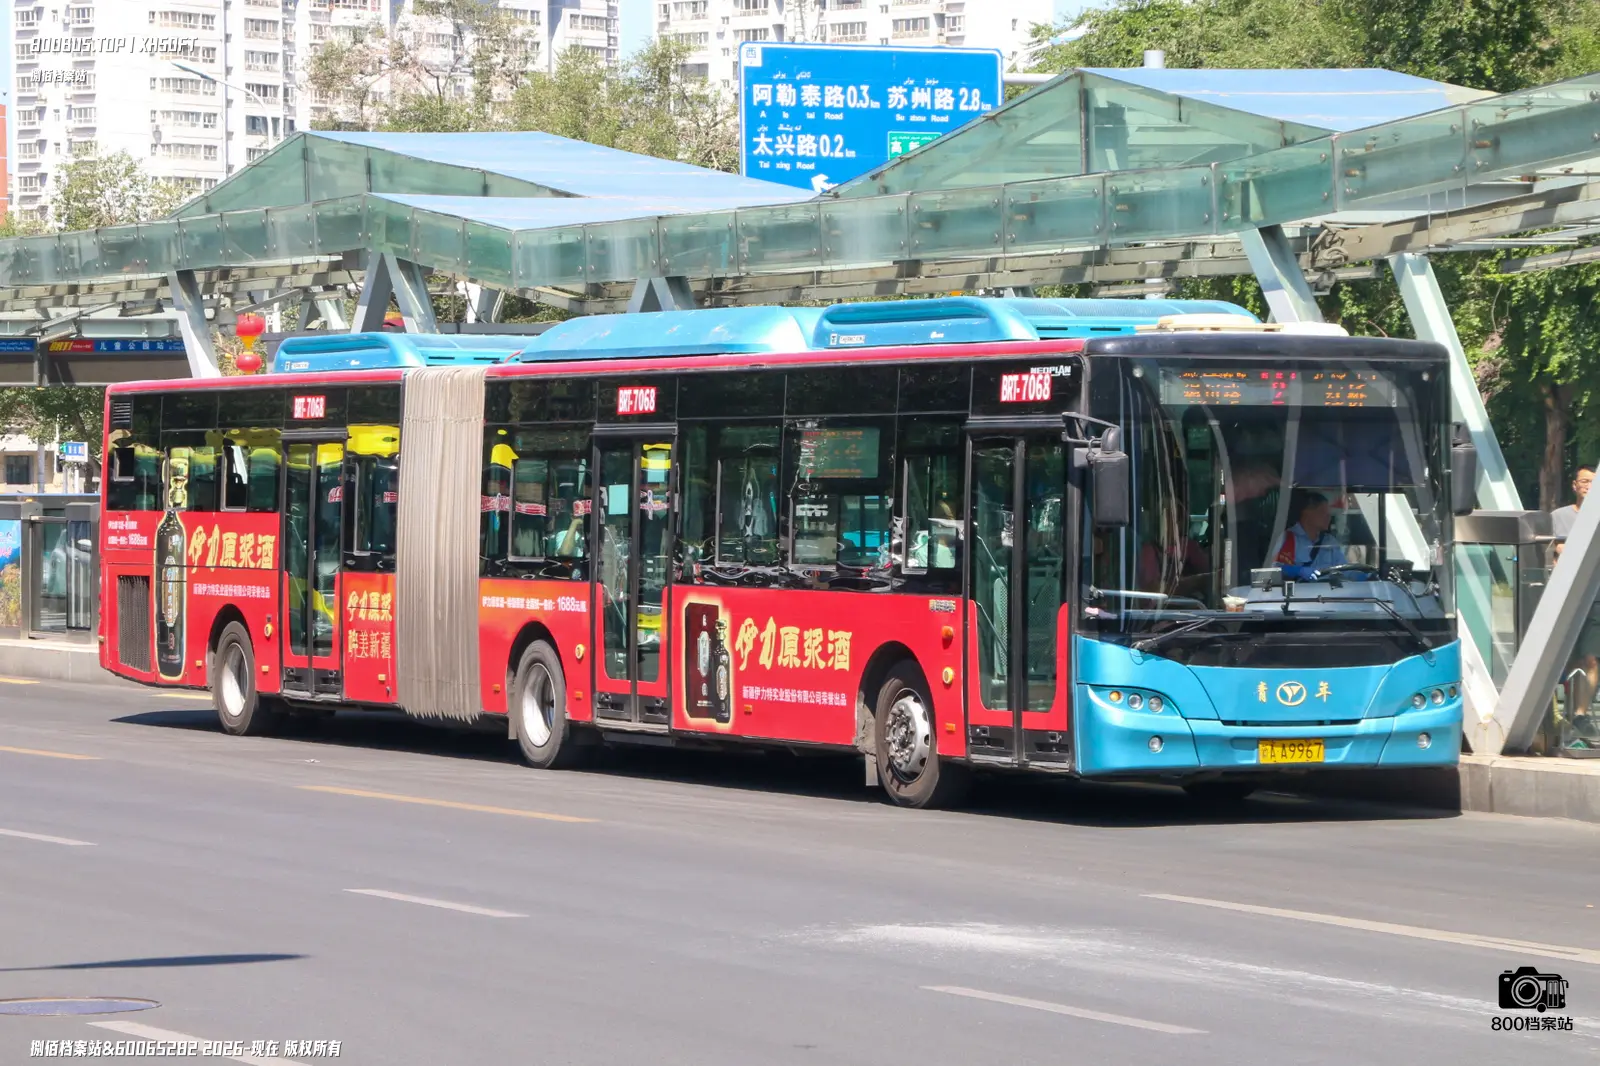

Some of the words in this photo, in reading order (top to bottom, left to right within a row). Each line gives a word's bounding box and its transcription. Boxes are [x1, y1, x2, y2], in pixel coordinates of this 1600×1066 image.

[752, 83, 845, 108] 阿勒泰路
[847, 84, 880, 109] 0.3km
[887, 86, 955, 110] 苏州路
[959, 88, 992, 111] 2.8km
[824, 112, 844, 120] Road
[909, 114, 927, 122] zhou
[752, 132, 818, 157] 太兴路
[819, 134, 856, 158] 0.2km
[796, 162, 815, 170] Road
[100, 341, 164, 350] 儿童公园站
[1030, 365, 1072, 376] NEOPLAN
[1001, 374, 1051, 401] BRT-7068
[294, 397, 325, 418] BRT-7068
[618, 388, 656, 412] BRT-7068
[188, 523, 276, 574] 伊力原浆酒
[735, 616, 853, 671] 伊力原浆酒
[742, 685, 847, 706] 新疆伊力特实业股份有限公司荣誉出品
[1257, 681, 1268, 703] 青
[1315, 681, 1332, 703] 年
